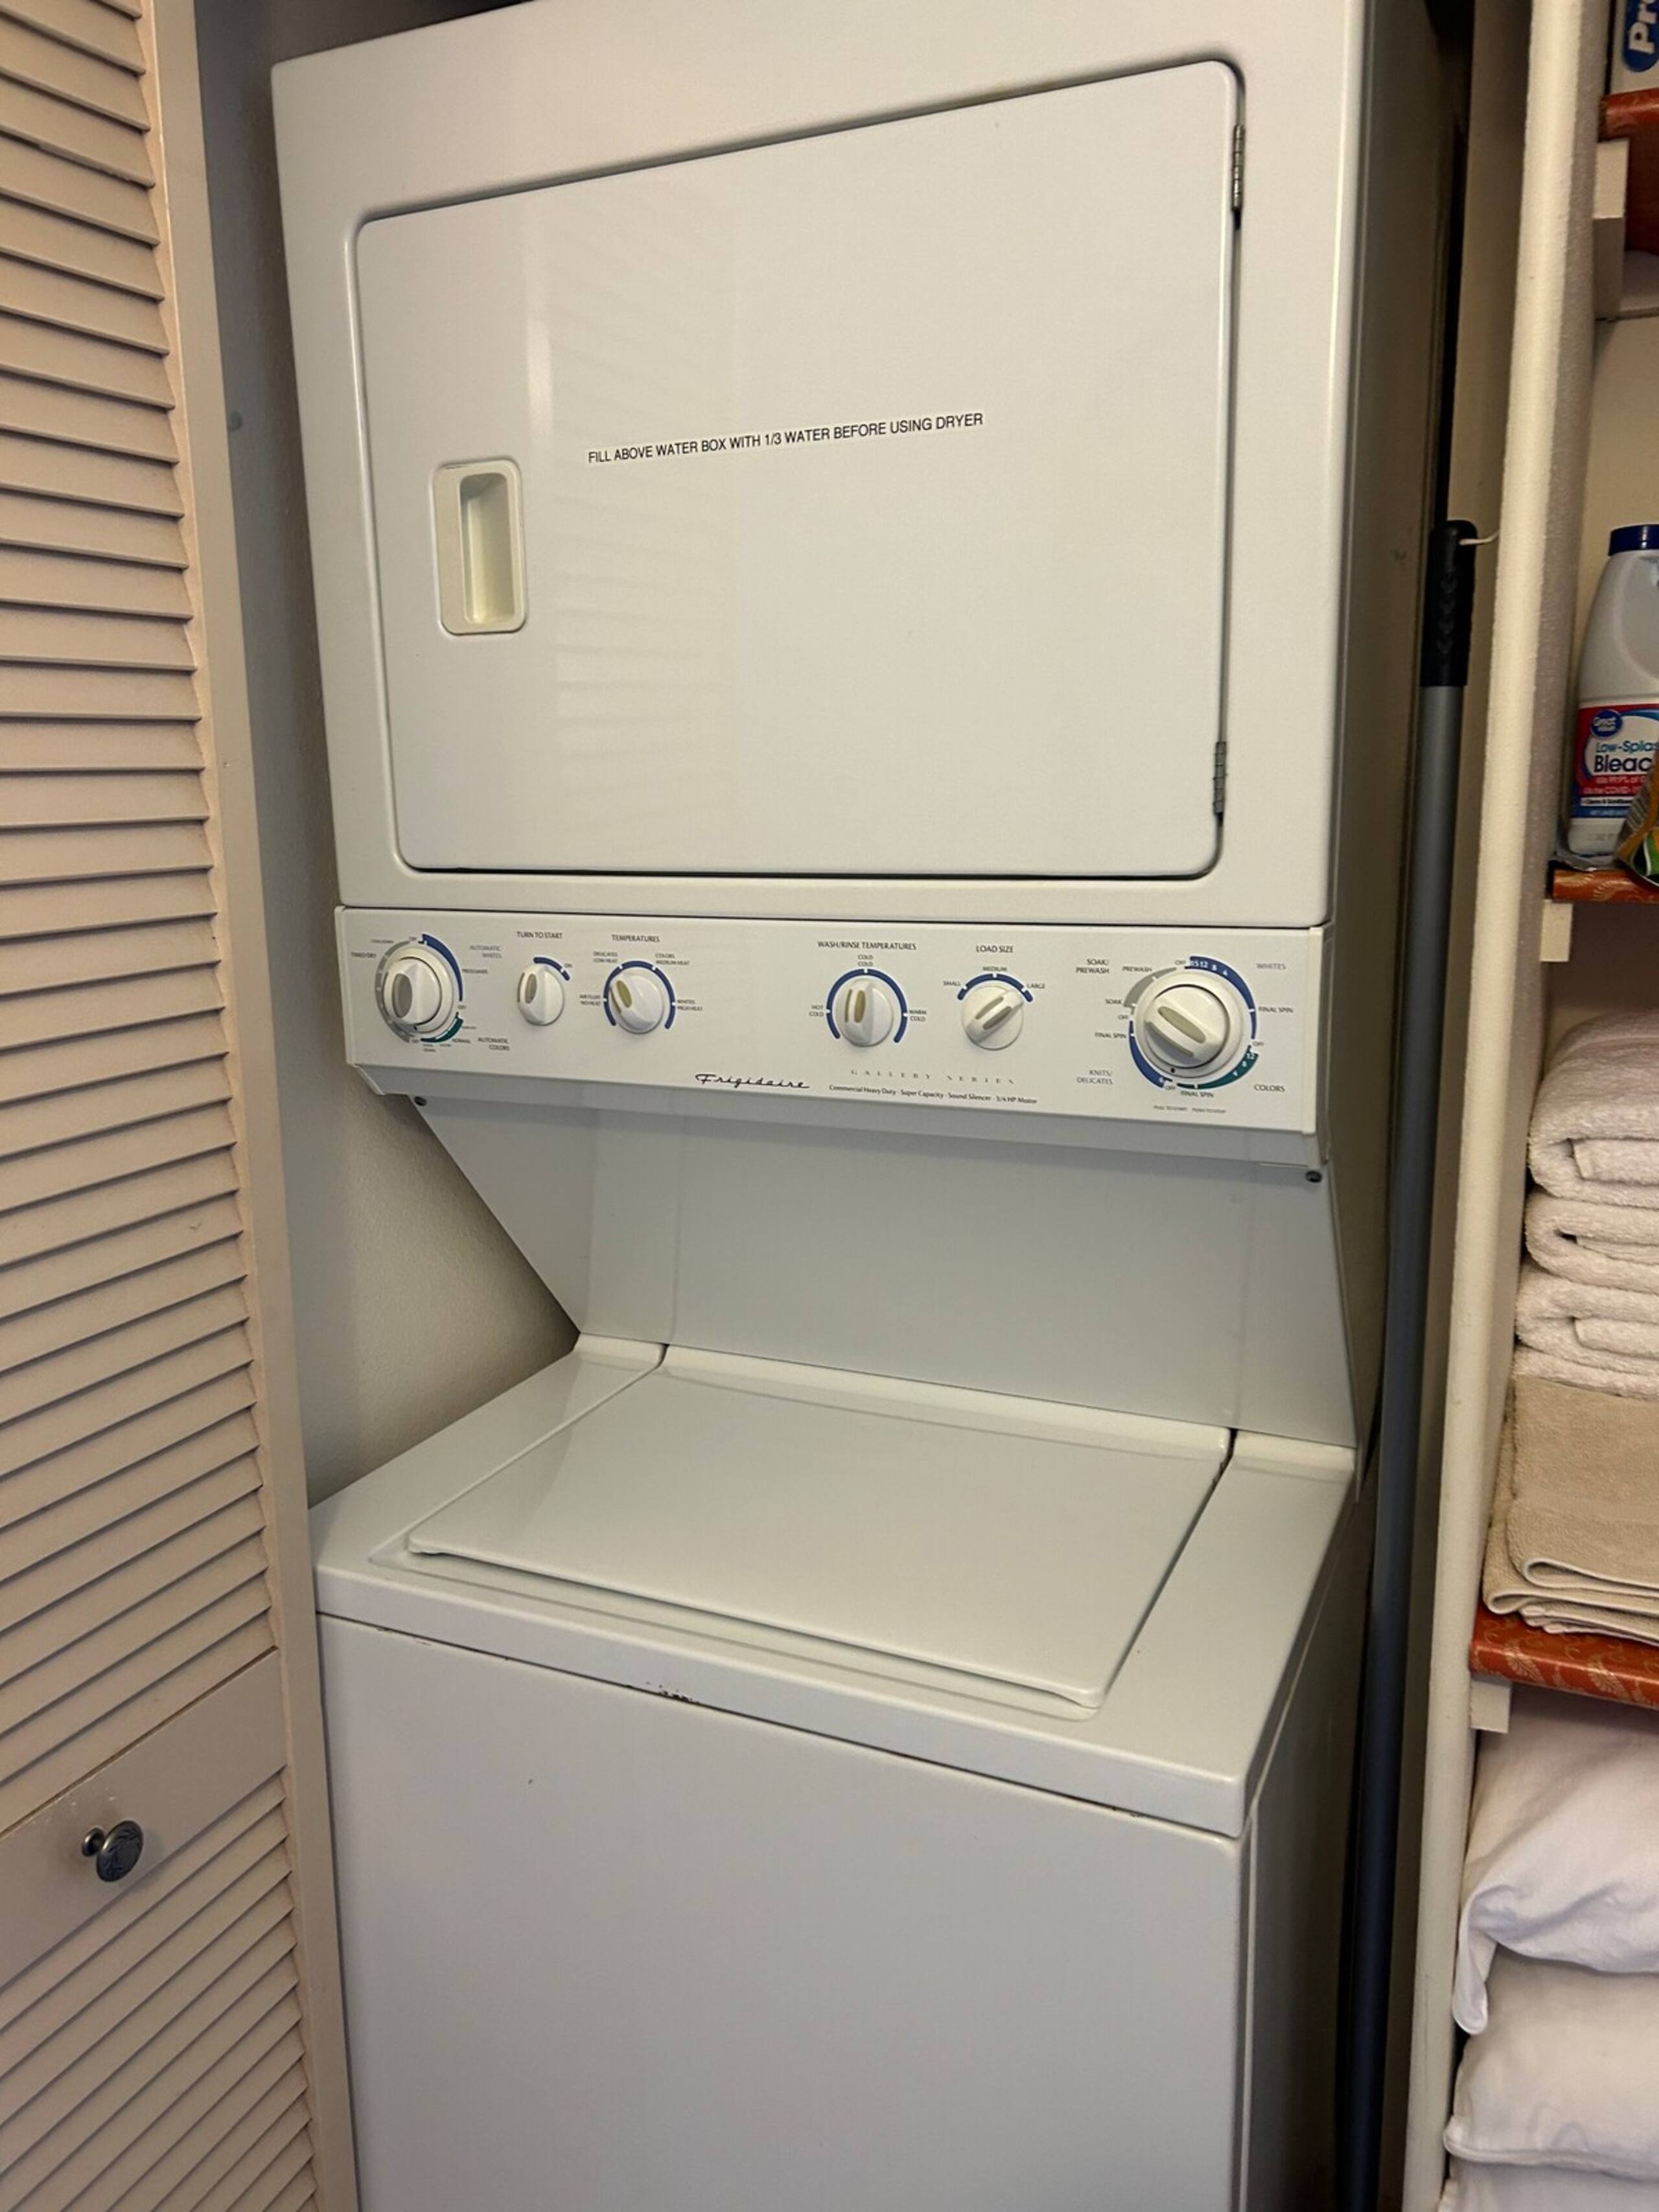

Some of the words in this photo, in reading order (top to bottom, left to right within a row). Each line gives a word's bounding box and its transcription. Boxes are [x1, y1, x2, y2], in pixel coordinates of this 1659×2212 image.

[1629, 0, 1658, 54] Pr
[588, 451, 611, 463] FILL
[614, 446, 653, 461] ABOVE
[656, 441, 698, 456] WATER
[702, 438, 726, 452] BOX
[730, 434, 761, 448] WITH
[765, 432, 782, 446] 1/3
[785, 428, 830, 443] WATER
[834, 422, 887, 439] BEFORE
[890, 417, 932, 433] USING
[936, 413, 984, 429] DRYER
[612, 935, 660, 943] TEMPERATURES
[862, 942, 916, 950] TEMPERATURES
[695, 1073, 810, 1089] Frigidaire
[1076, 1077, 1113, 1085] DELICATES
[829, 1084, 863, 1093] Commercial
[918, 1090, 944, 1099] Capacity
[1254, 1084, 1285, 1092] COLORS
